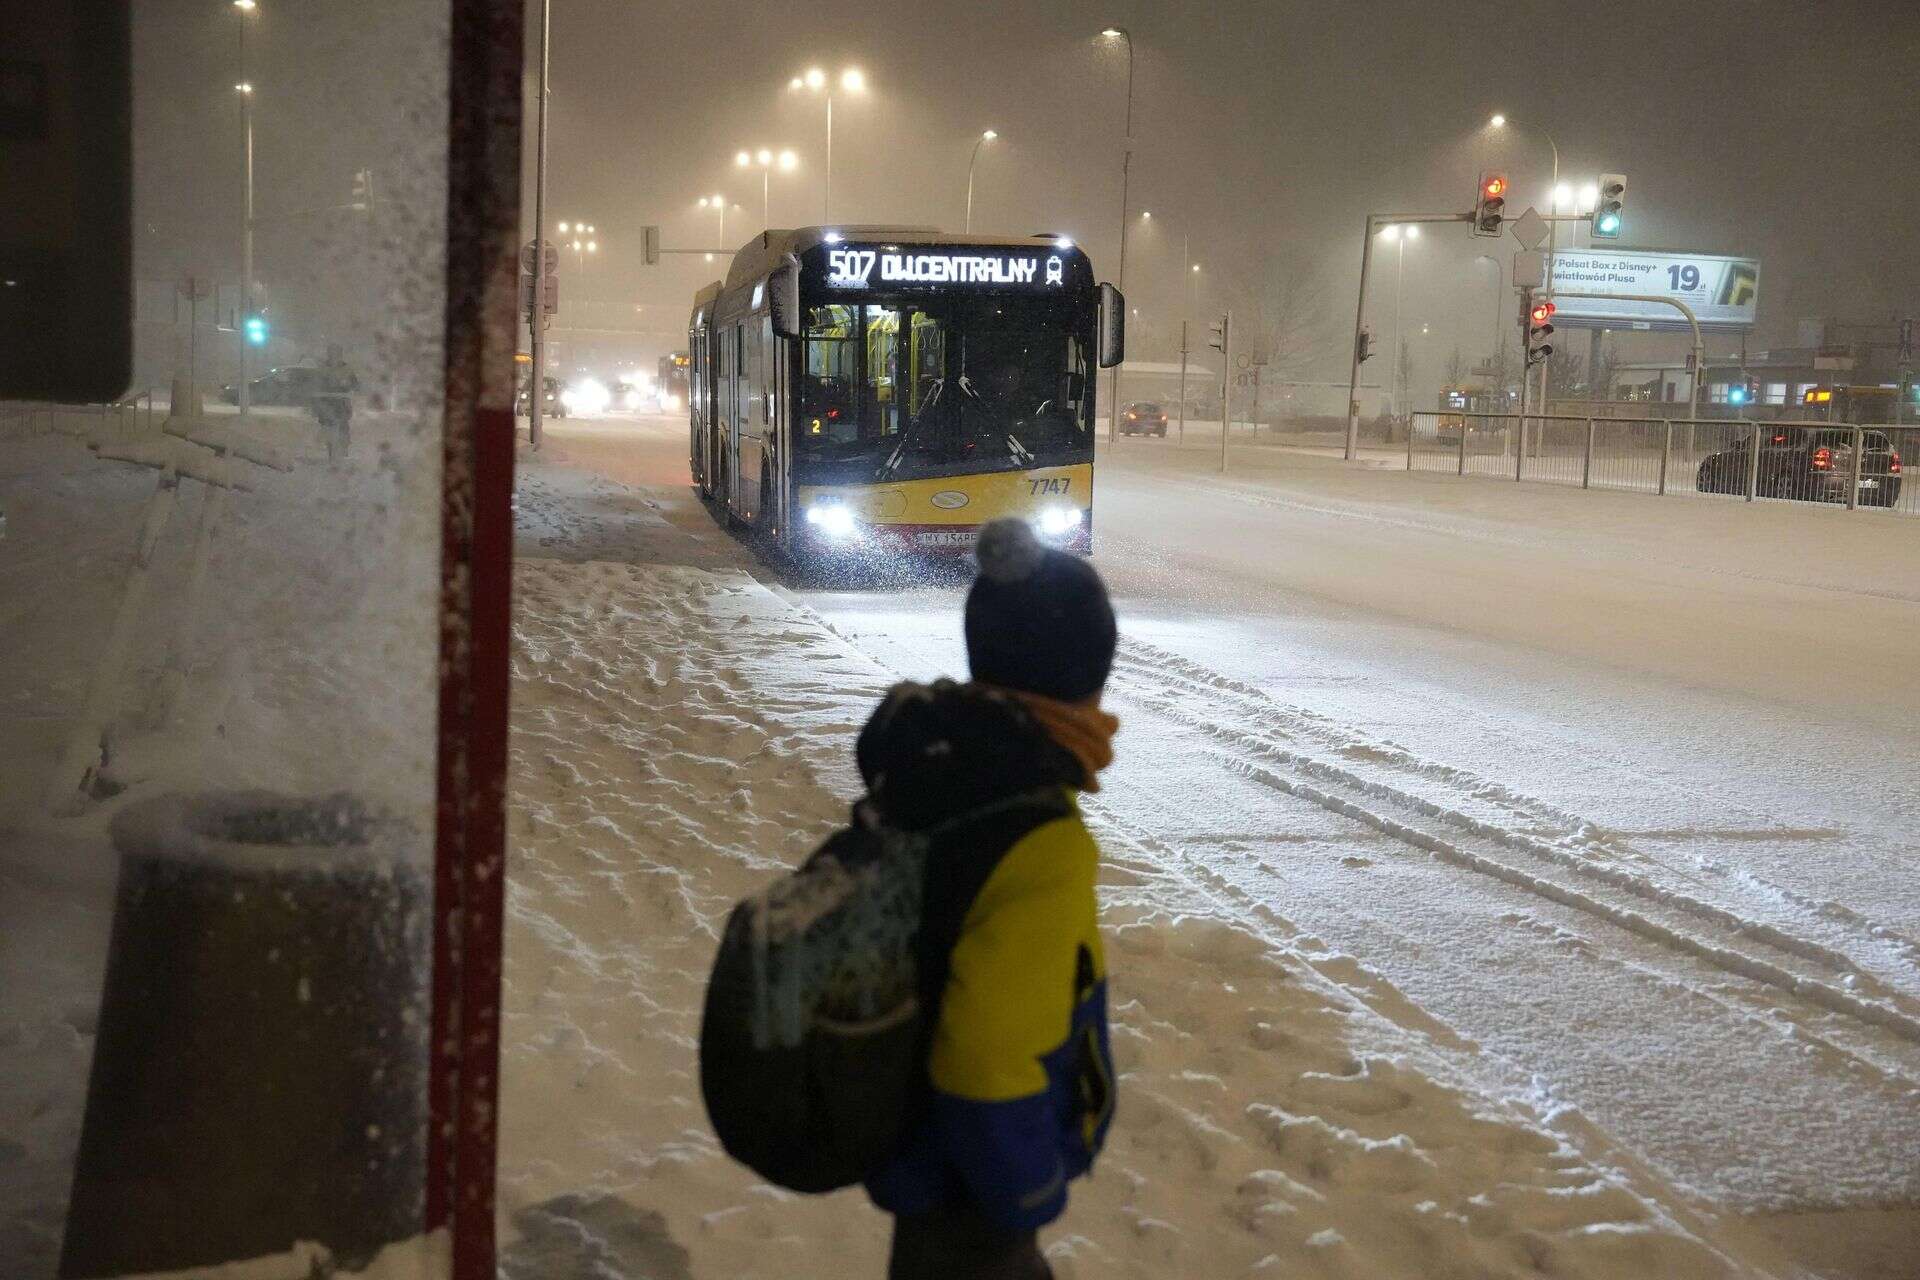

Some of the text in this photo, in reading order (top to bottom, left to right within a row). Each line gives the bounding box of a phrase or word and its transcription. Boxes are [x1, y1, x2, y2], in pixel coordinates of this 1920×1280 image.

[830, 250, 876, 281] 507
[1559, 259, 1589, 269] Polsat
[1592, 260, 1610, 269] Box
[1619, 261, 1657, 273] Disney+
[1552, 270, 1635, 283] wiatłowód Plusa
[1667, 264, 1700, 291] 19
[812, 419, 821, 433] 2
[1028, 477, 1072, 496] 7747
